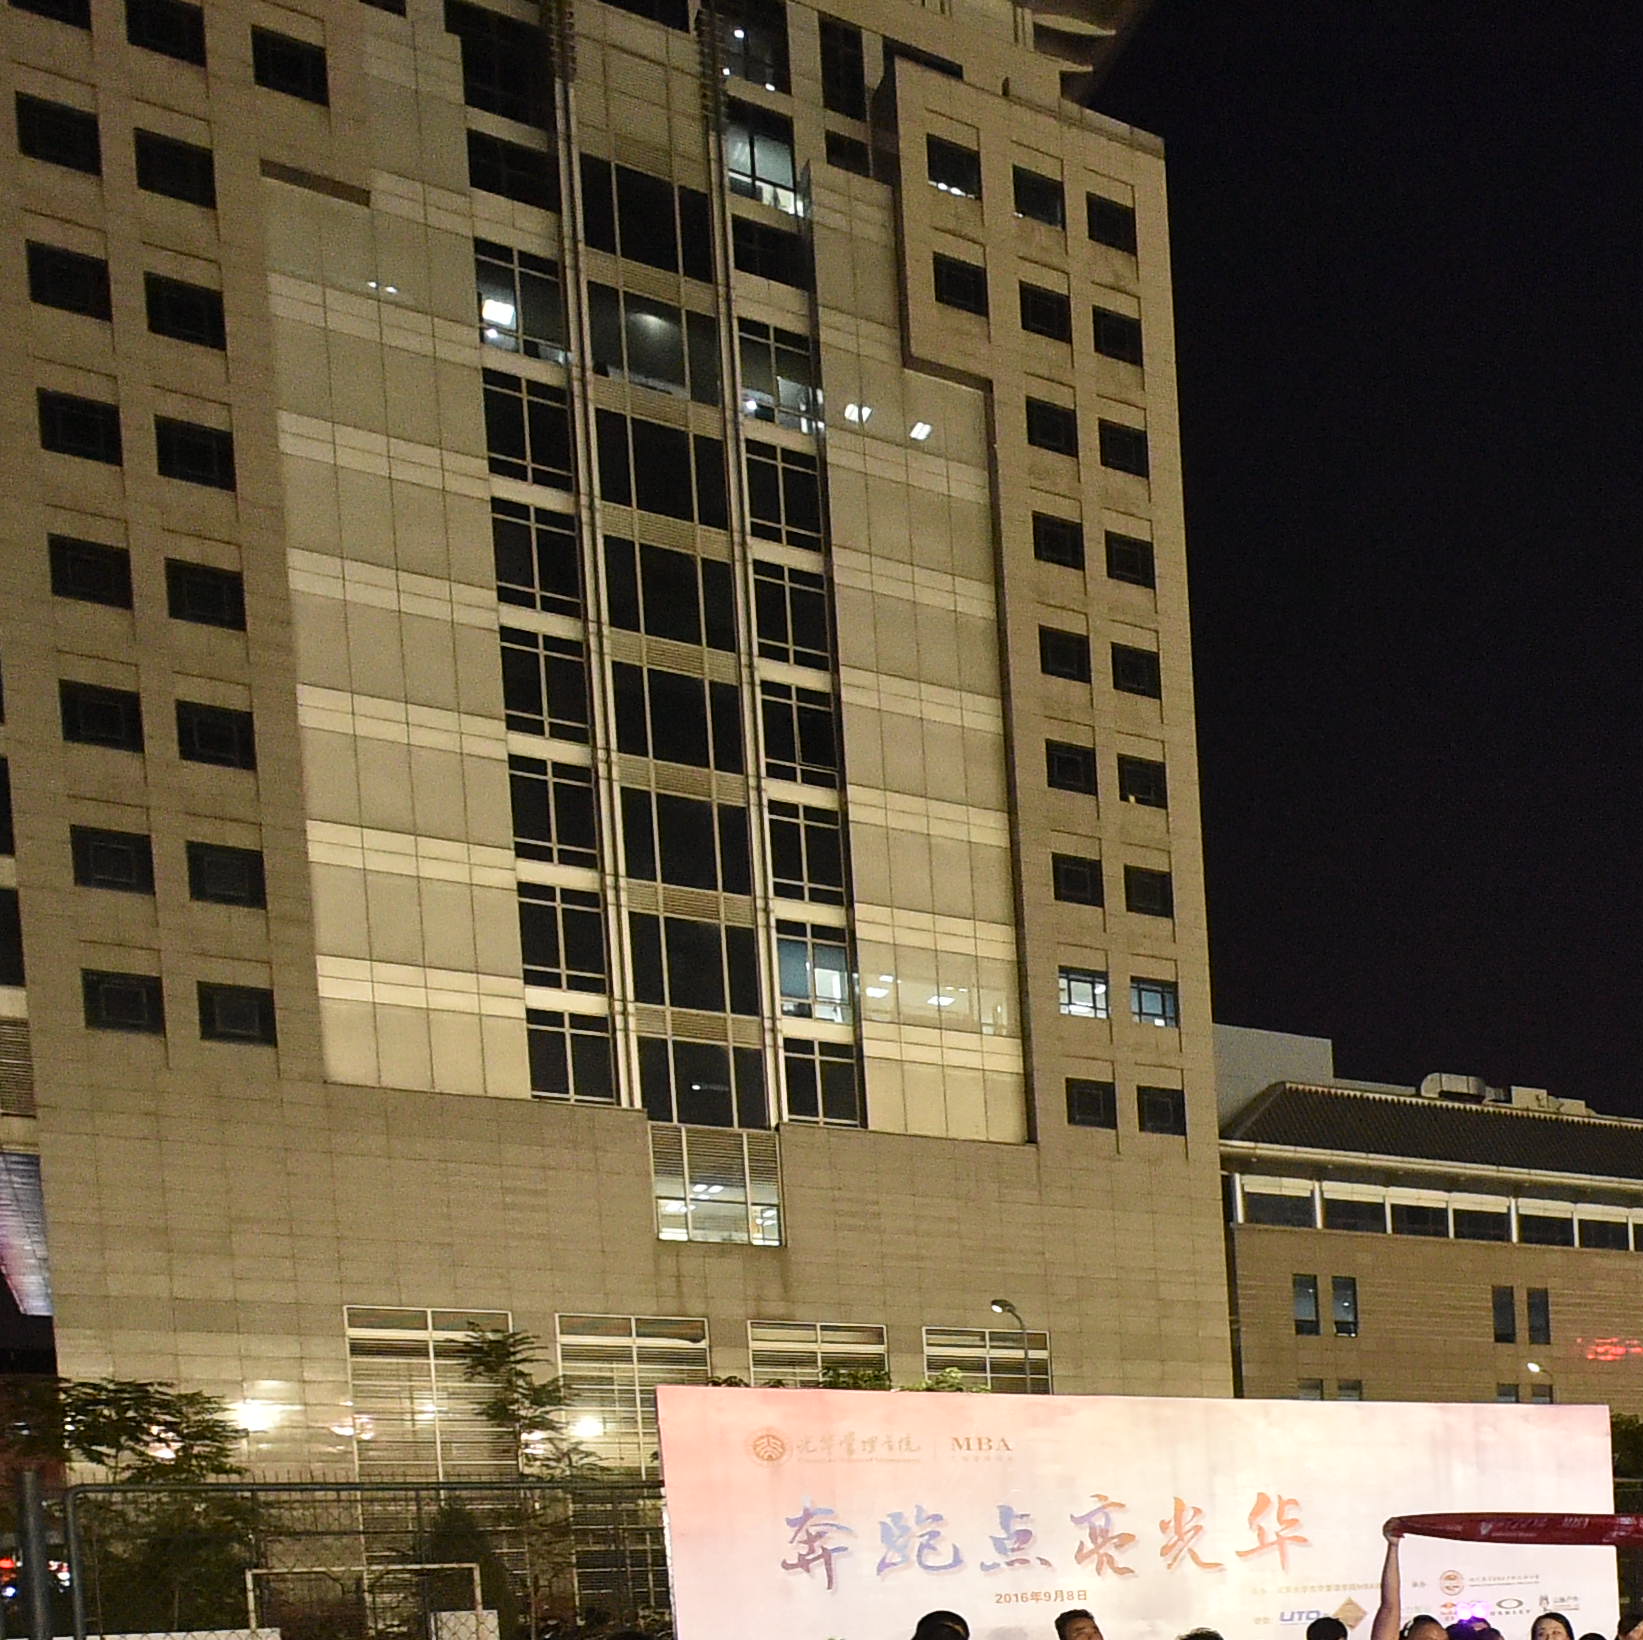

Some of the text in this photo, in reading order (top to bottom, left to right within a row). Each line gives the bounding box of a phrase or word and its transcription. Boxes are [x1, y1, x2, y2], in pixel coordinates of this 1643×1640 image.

[951, 1437, 1013, 1451] MBA
[781, 1492, 1311, 1591] 奔跑点亮光华
[994, 1589, 1088, 1604] 2016年9月8日
